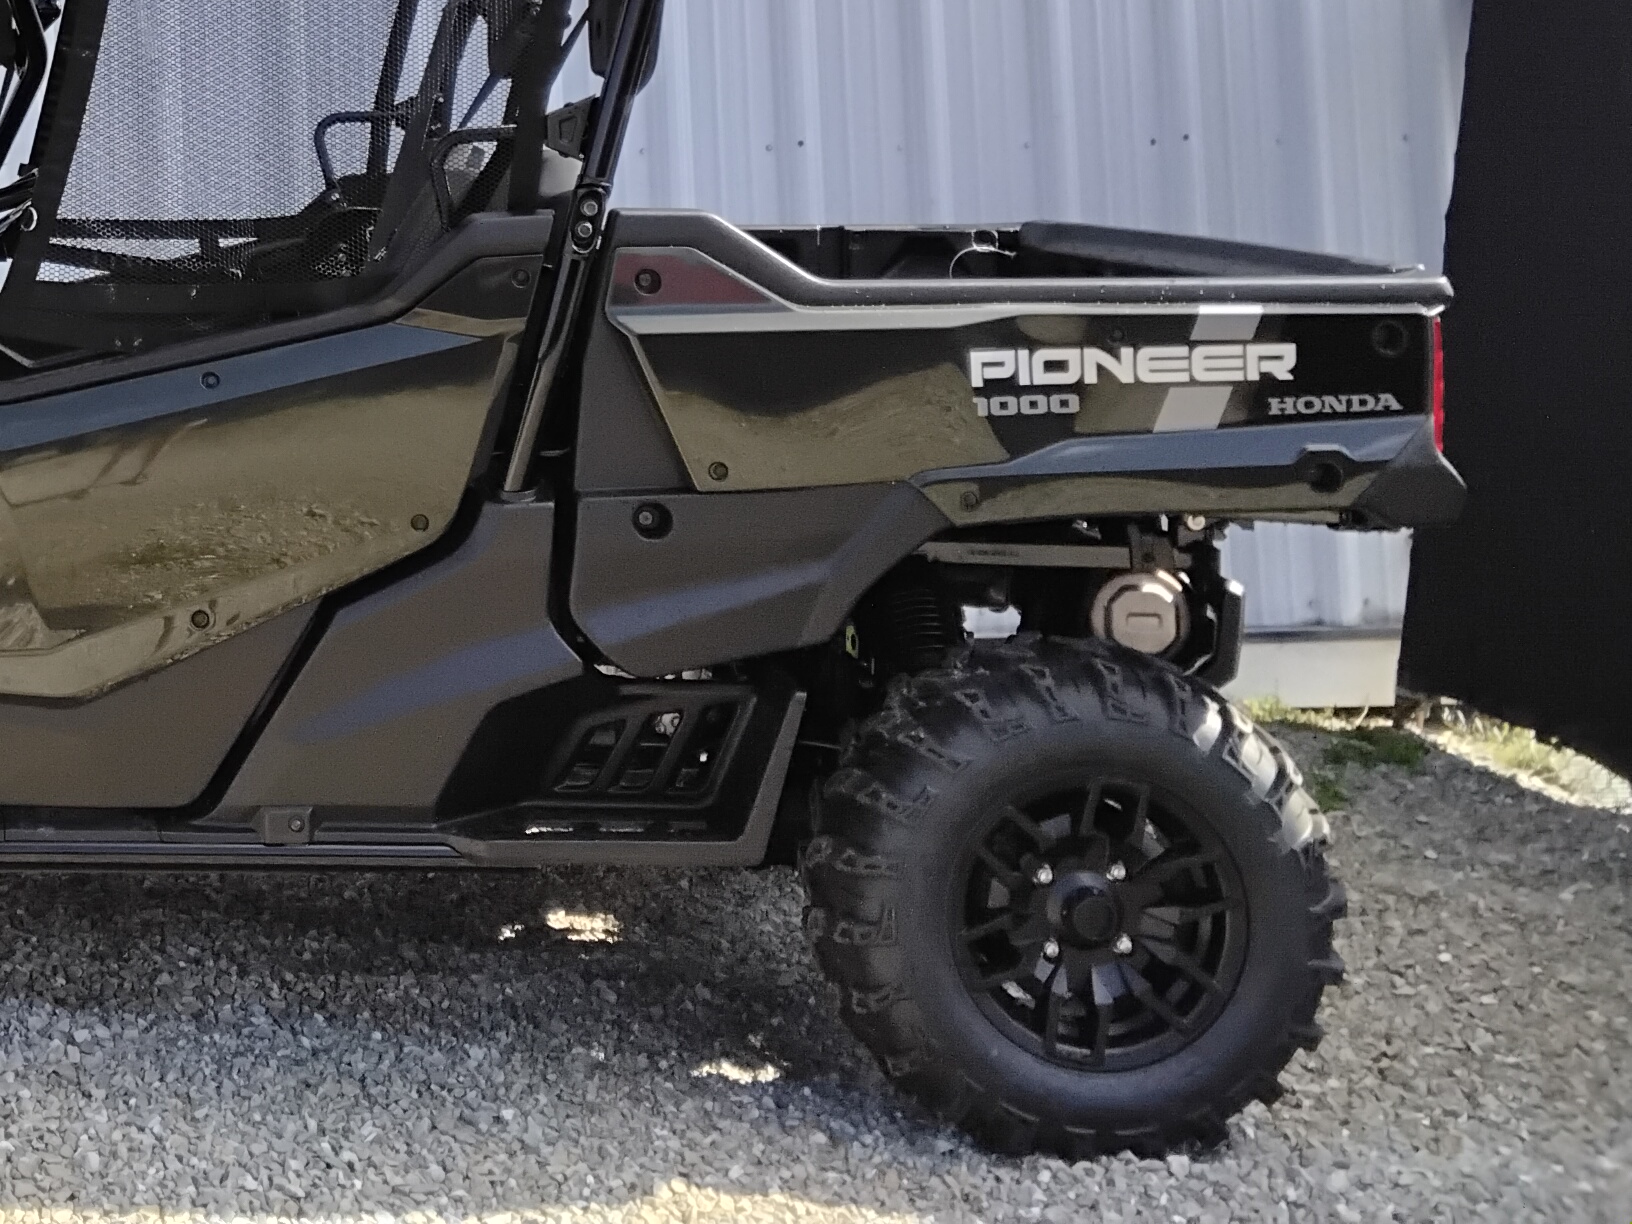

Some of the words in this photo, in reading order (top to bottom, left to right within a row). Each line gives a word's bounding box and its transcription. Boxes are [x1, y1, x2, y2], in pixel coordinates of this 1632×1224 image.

[970, 342, 1297, 387] PIONEER
[972, 393, 1080, 417] 1000
[1268, 392, 1404, 416] HONDA
